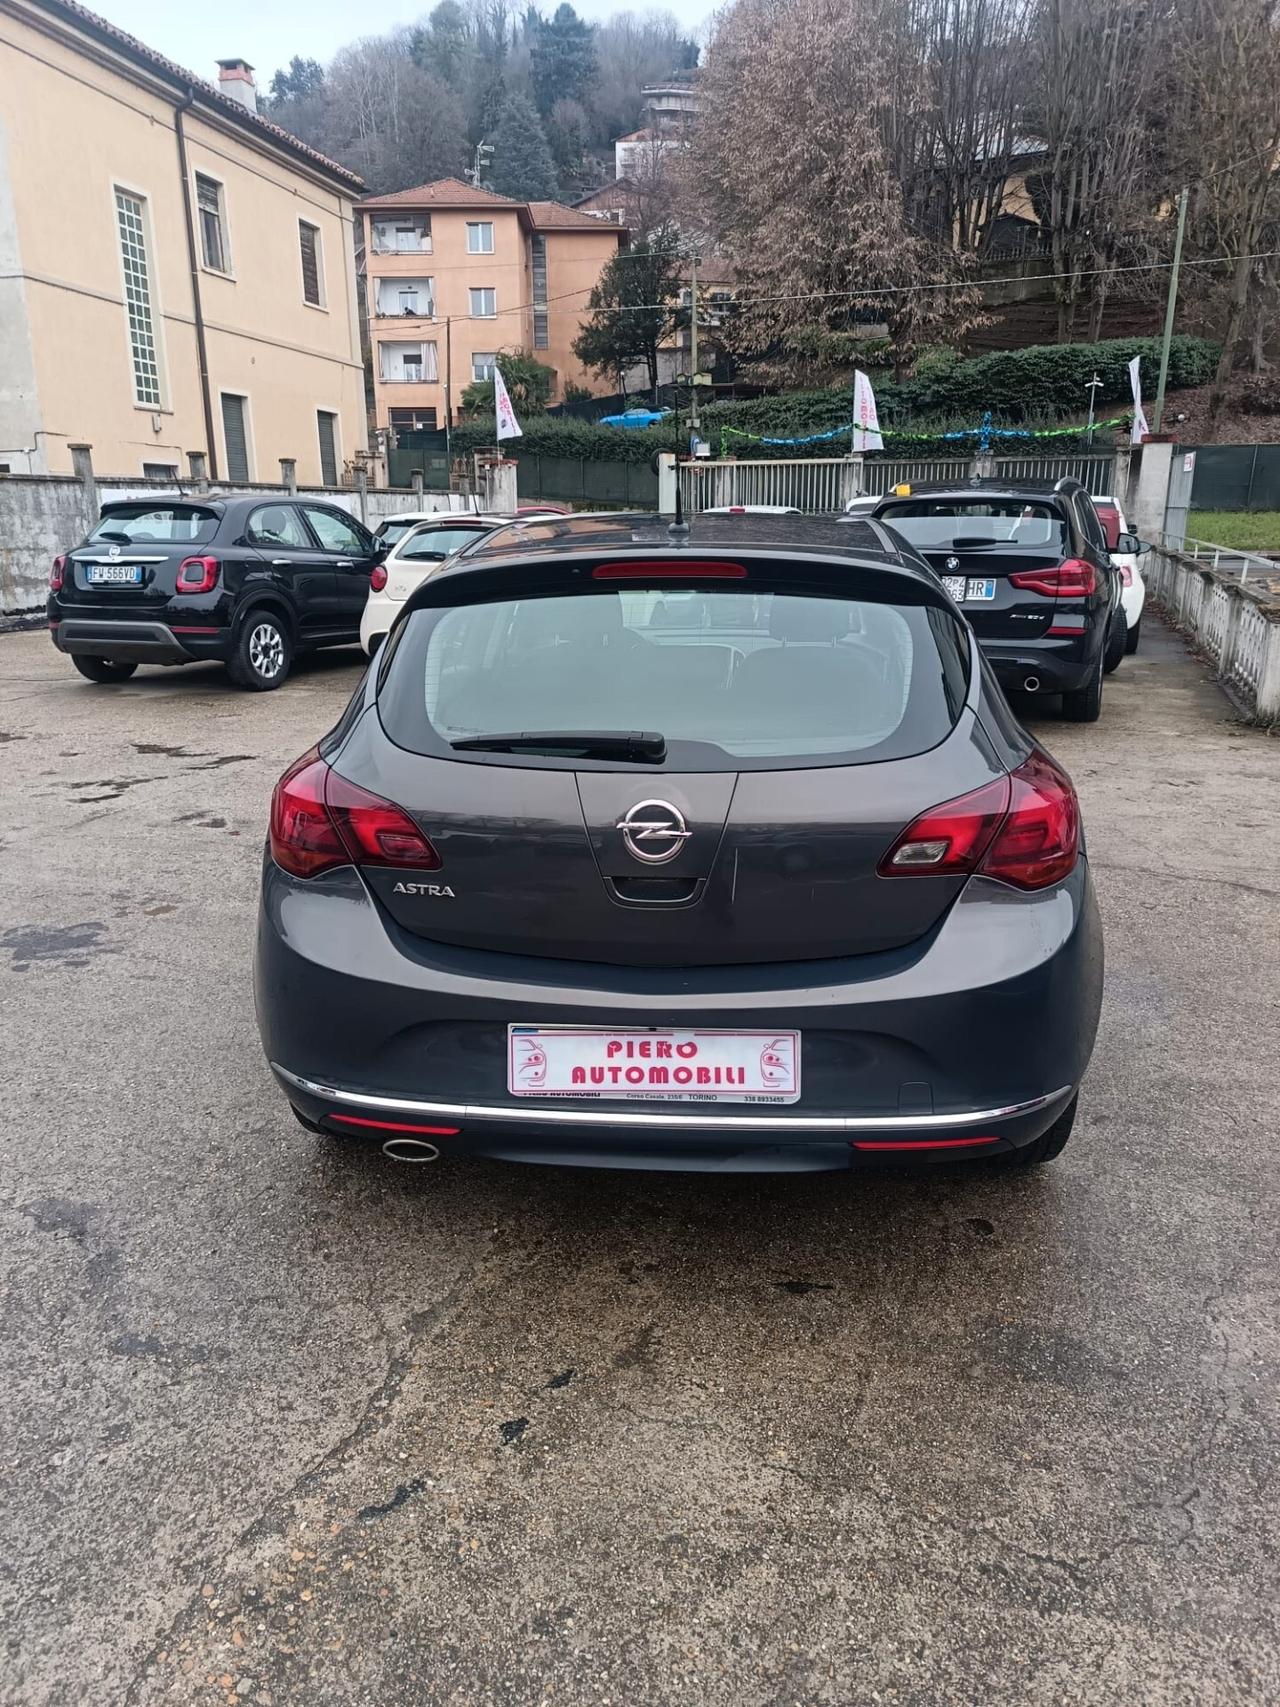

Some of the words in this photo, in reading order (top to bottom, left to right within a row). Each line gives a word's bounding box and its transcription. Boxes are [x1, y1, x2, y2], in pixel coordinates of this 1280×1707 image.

[393, 882, 456, 897] ASTRA
[607, 1040, 698, 1059] PIERO
[571, 1066, 745, 1085] AUTOMOBILI
[688, 1093, 718, 1101] TORINO
